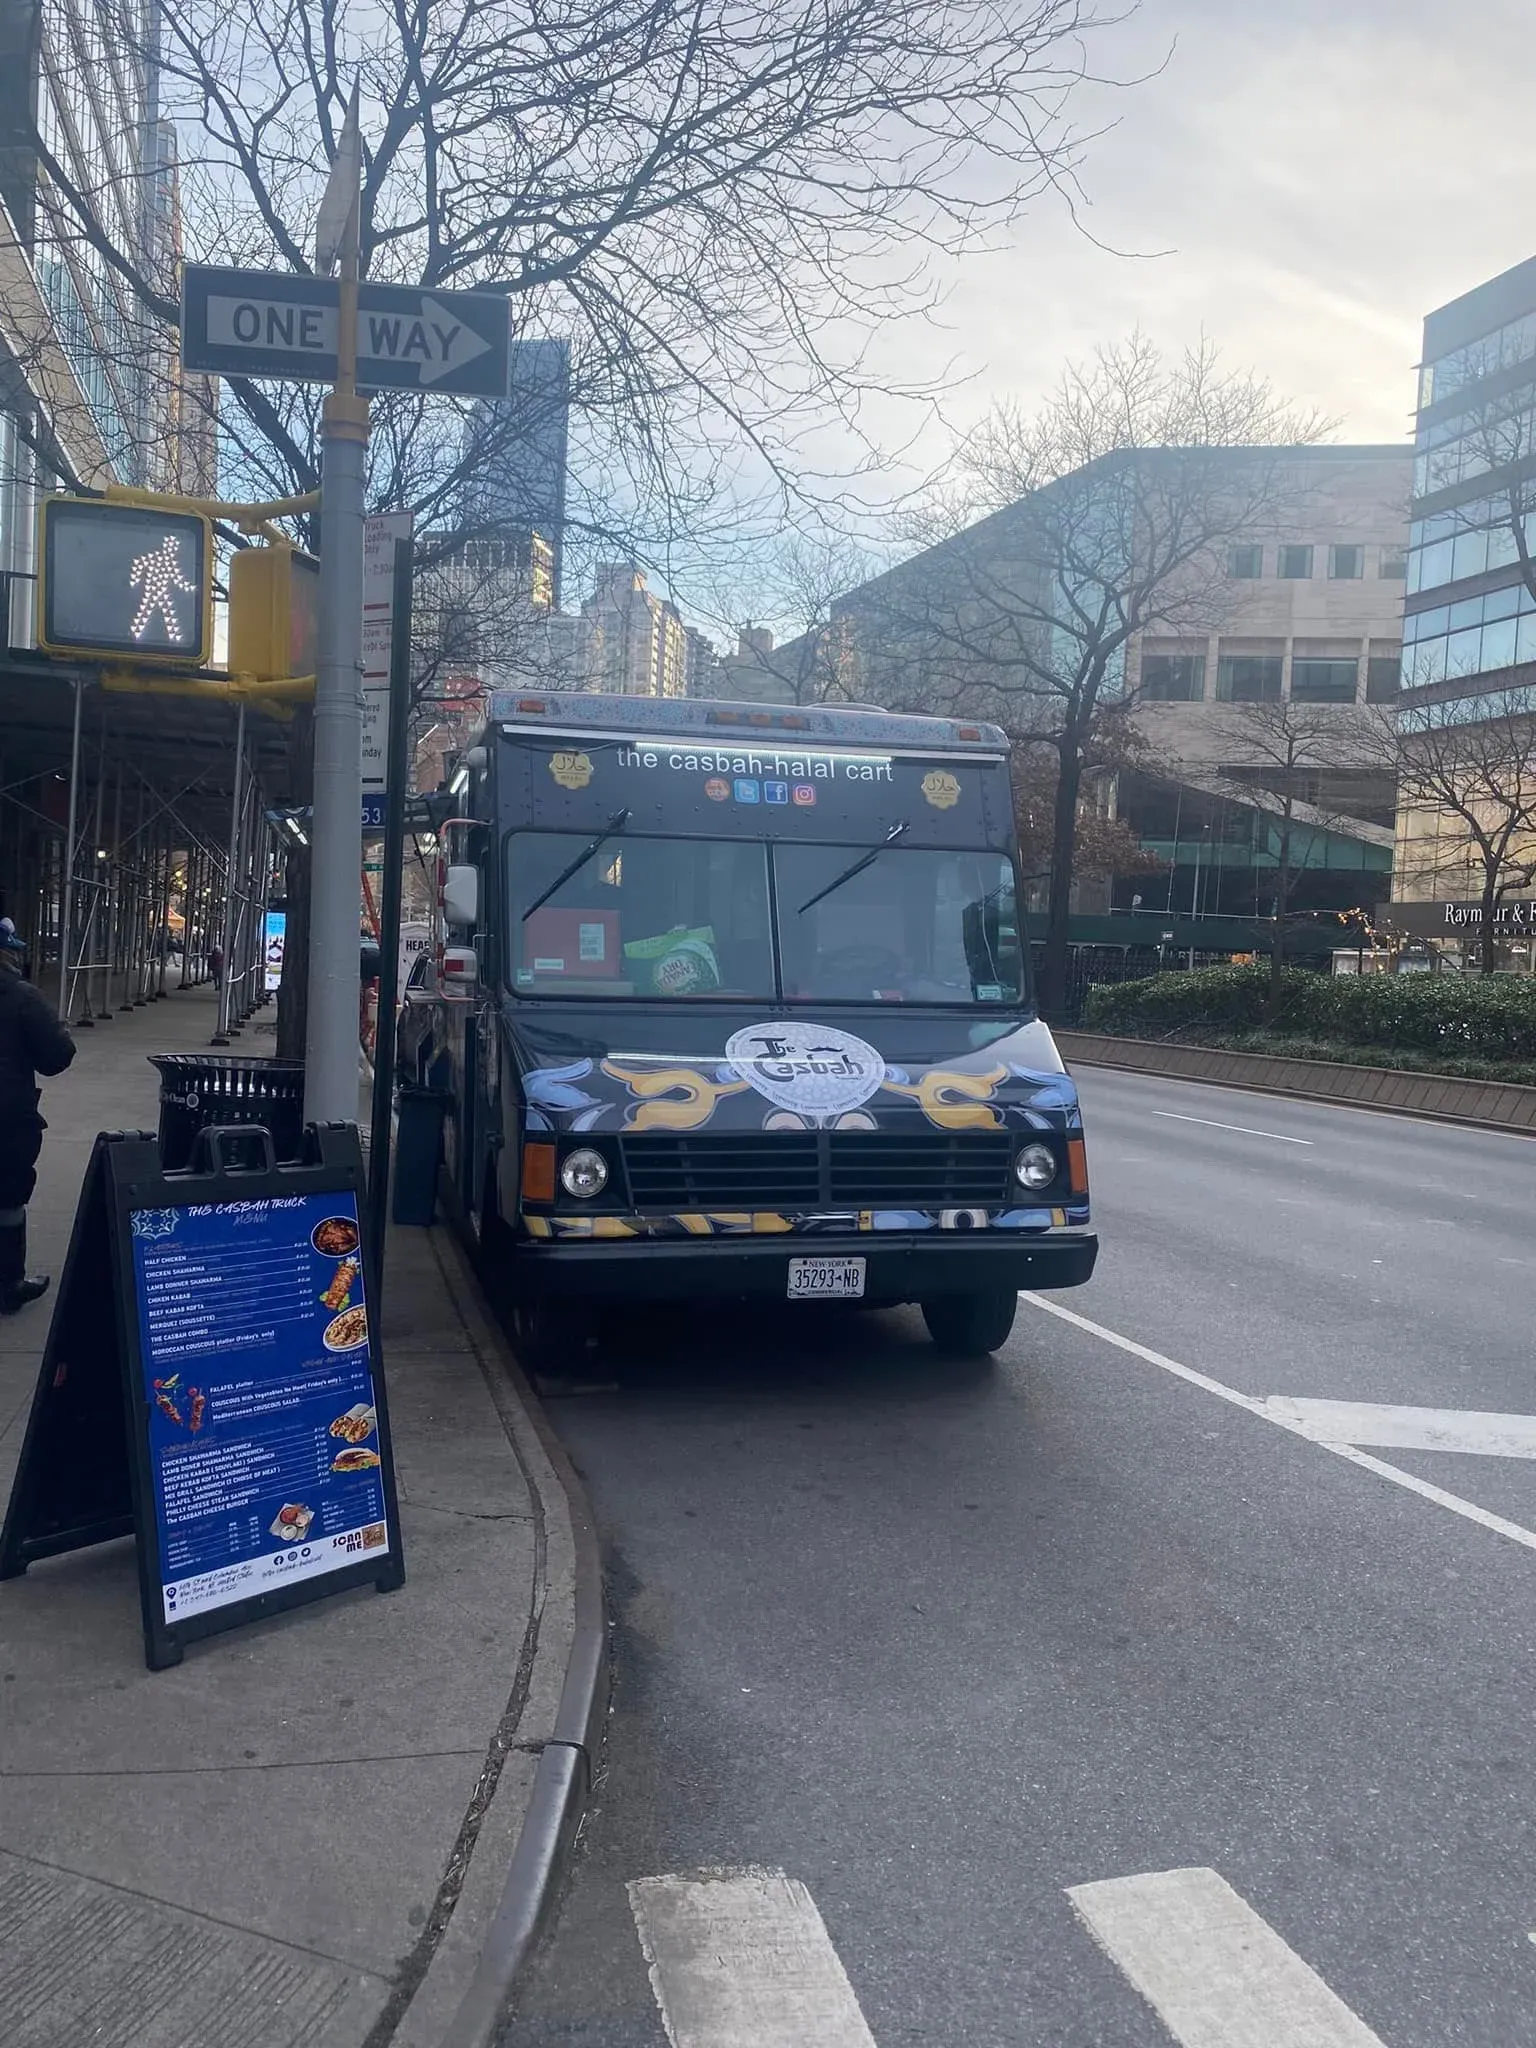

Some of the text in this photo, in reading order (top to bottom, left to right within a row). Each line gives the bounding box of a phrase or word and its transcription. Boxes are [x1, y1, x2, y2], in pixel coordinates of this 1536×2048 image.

[233, 304, 461, 361] ONE WAY
[617, 748, 894, 782] the casbah-halal cart
[1444, 903, 1508, 927] Raymur
[1512, 903, 1523, 924] &
[1476, 927, 1536, 936] FRNITU
[750, 1037, 797, 1059] The
[752, 1054, 864, 1082] Casbah
[188, 1195, 308, 1217] THE CASBAH TRUCK
[160, 1254, 186, 1263] CHICKEN
[145, 1269, 171, 1278] CHICKEN
[146, 1283, 164, 1291] LAMB
[148, 1309, 163, 1317] BEEF
[151, 1328, 208, 1343] THE CASBAH COMBO
[151, 1345, 184, 1356] MOROCCAN
[185, 1340, 215, 1350] COUSCOUS
[210, 1383, 234, 1393] FALAFEL
[211, 1396, 240, 1408] COUSCOUS
[253, 1401, 281, 1412] COUSCOUS
[161, 1457, 187, 1468] CHICKEN
[222, 1442, 251, 1454] SANDWICH
[162, 1467, 179, 1476] LAMB
[235, 1447, 264, 1459] SANDWICH
[163, 1473, 189, 1484] CHICKEN
[246, 1452, 275, 1464] SANDWICH
[163, 1484, 179, 1492] BEEF
[220, 1467, 250, 1478] SANDWICH
[195, 1480, 225, 1492] SANDWICH
[165, 1489, 223, 1508] FALAFEL SANDWICH
[166, 1506, 186, 1516] PHILLY
[187, 1500, 209, 1511] CHEESE
[230, 1488, 259, 1499] SANDWICH
[202, 1504, 225, 1515] CHEESE
[226, 1498, 248, 1509] BURGER
[346, 1540, 363, 1553] ME
